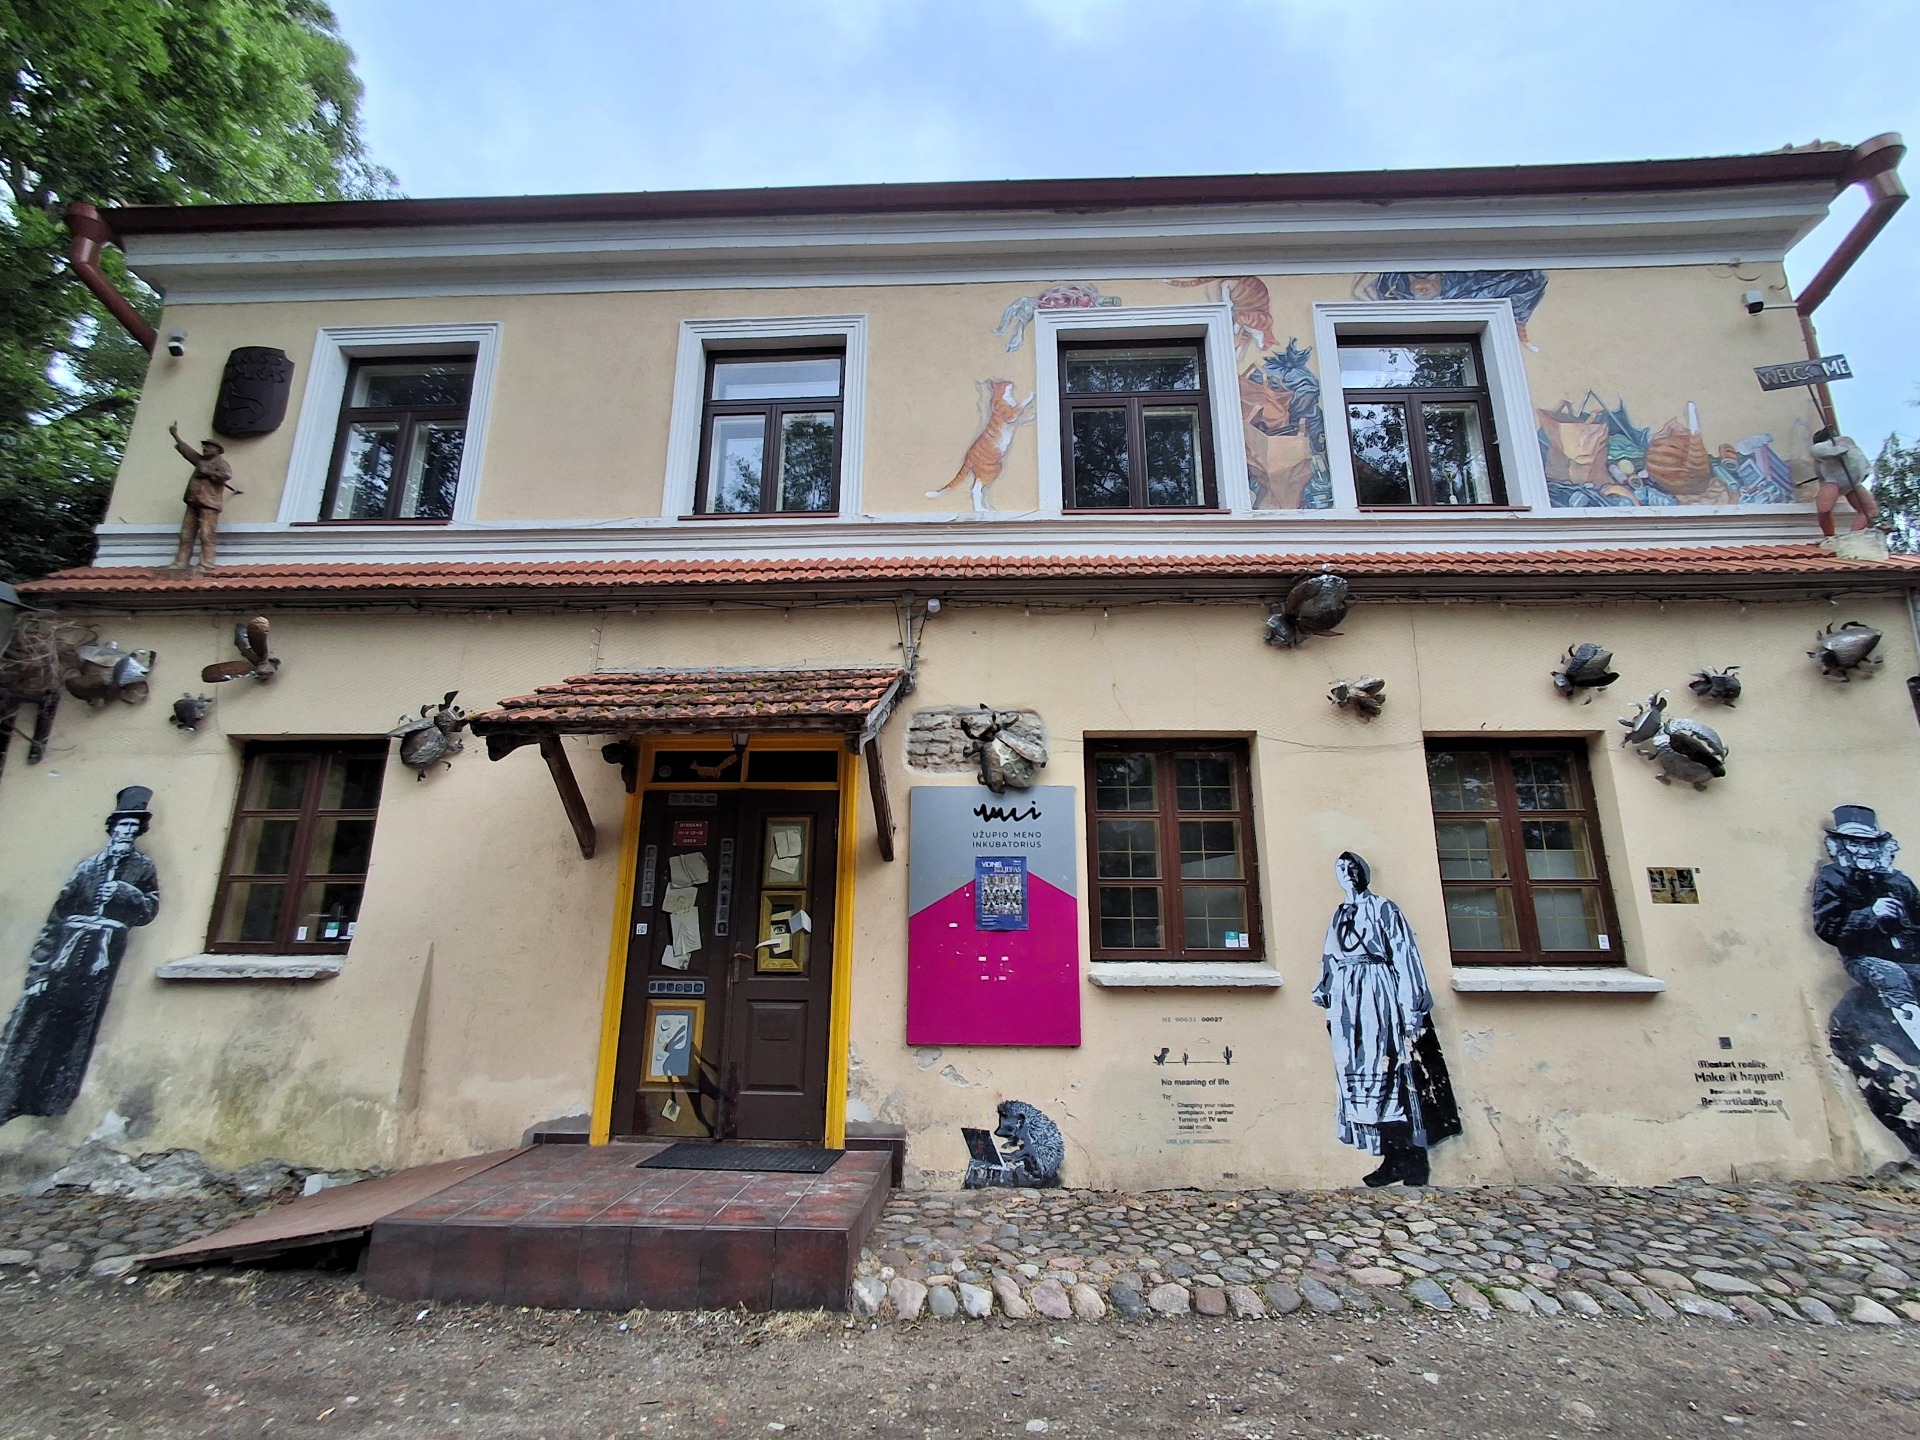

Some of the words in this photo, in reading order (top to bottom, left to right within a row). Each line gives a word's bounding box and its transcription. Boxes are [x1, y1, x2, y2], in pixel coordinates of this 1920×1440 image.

[972, 830, 1009, 839] UŽUPIO
[1013, 831, 1042, 839] MENO
[1694, 1071, 1726, 1083] Make
[1729, 1071, 1738, 1081] it
[1740, 1070, 1784, 1084] happen!
[1161, 1078, 1173, 1086] No
[1174, 1078, 1206, 1087] meaning
[1208, 1078, 1216, 1086] of
[1218, 1078, 1230, 1086] life
